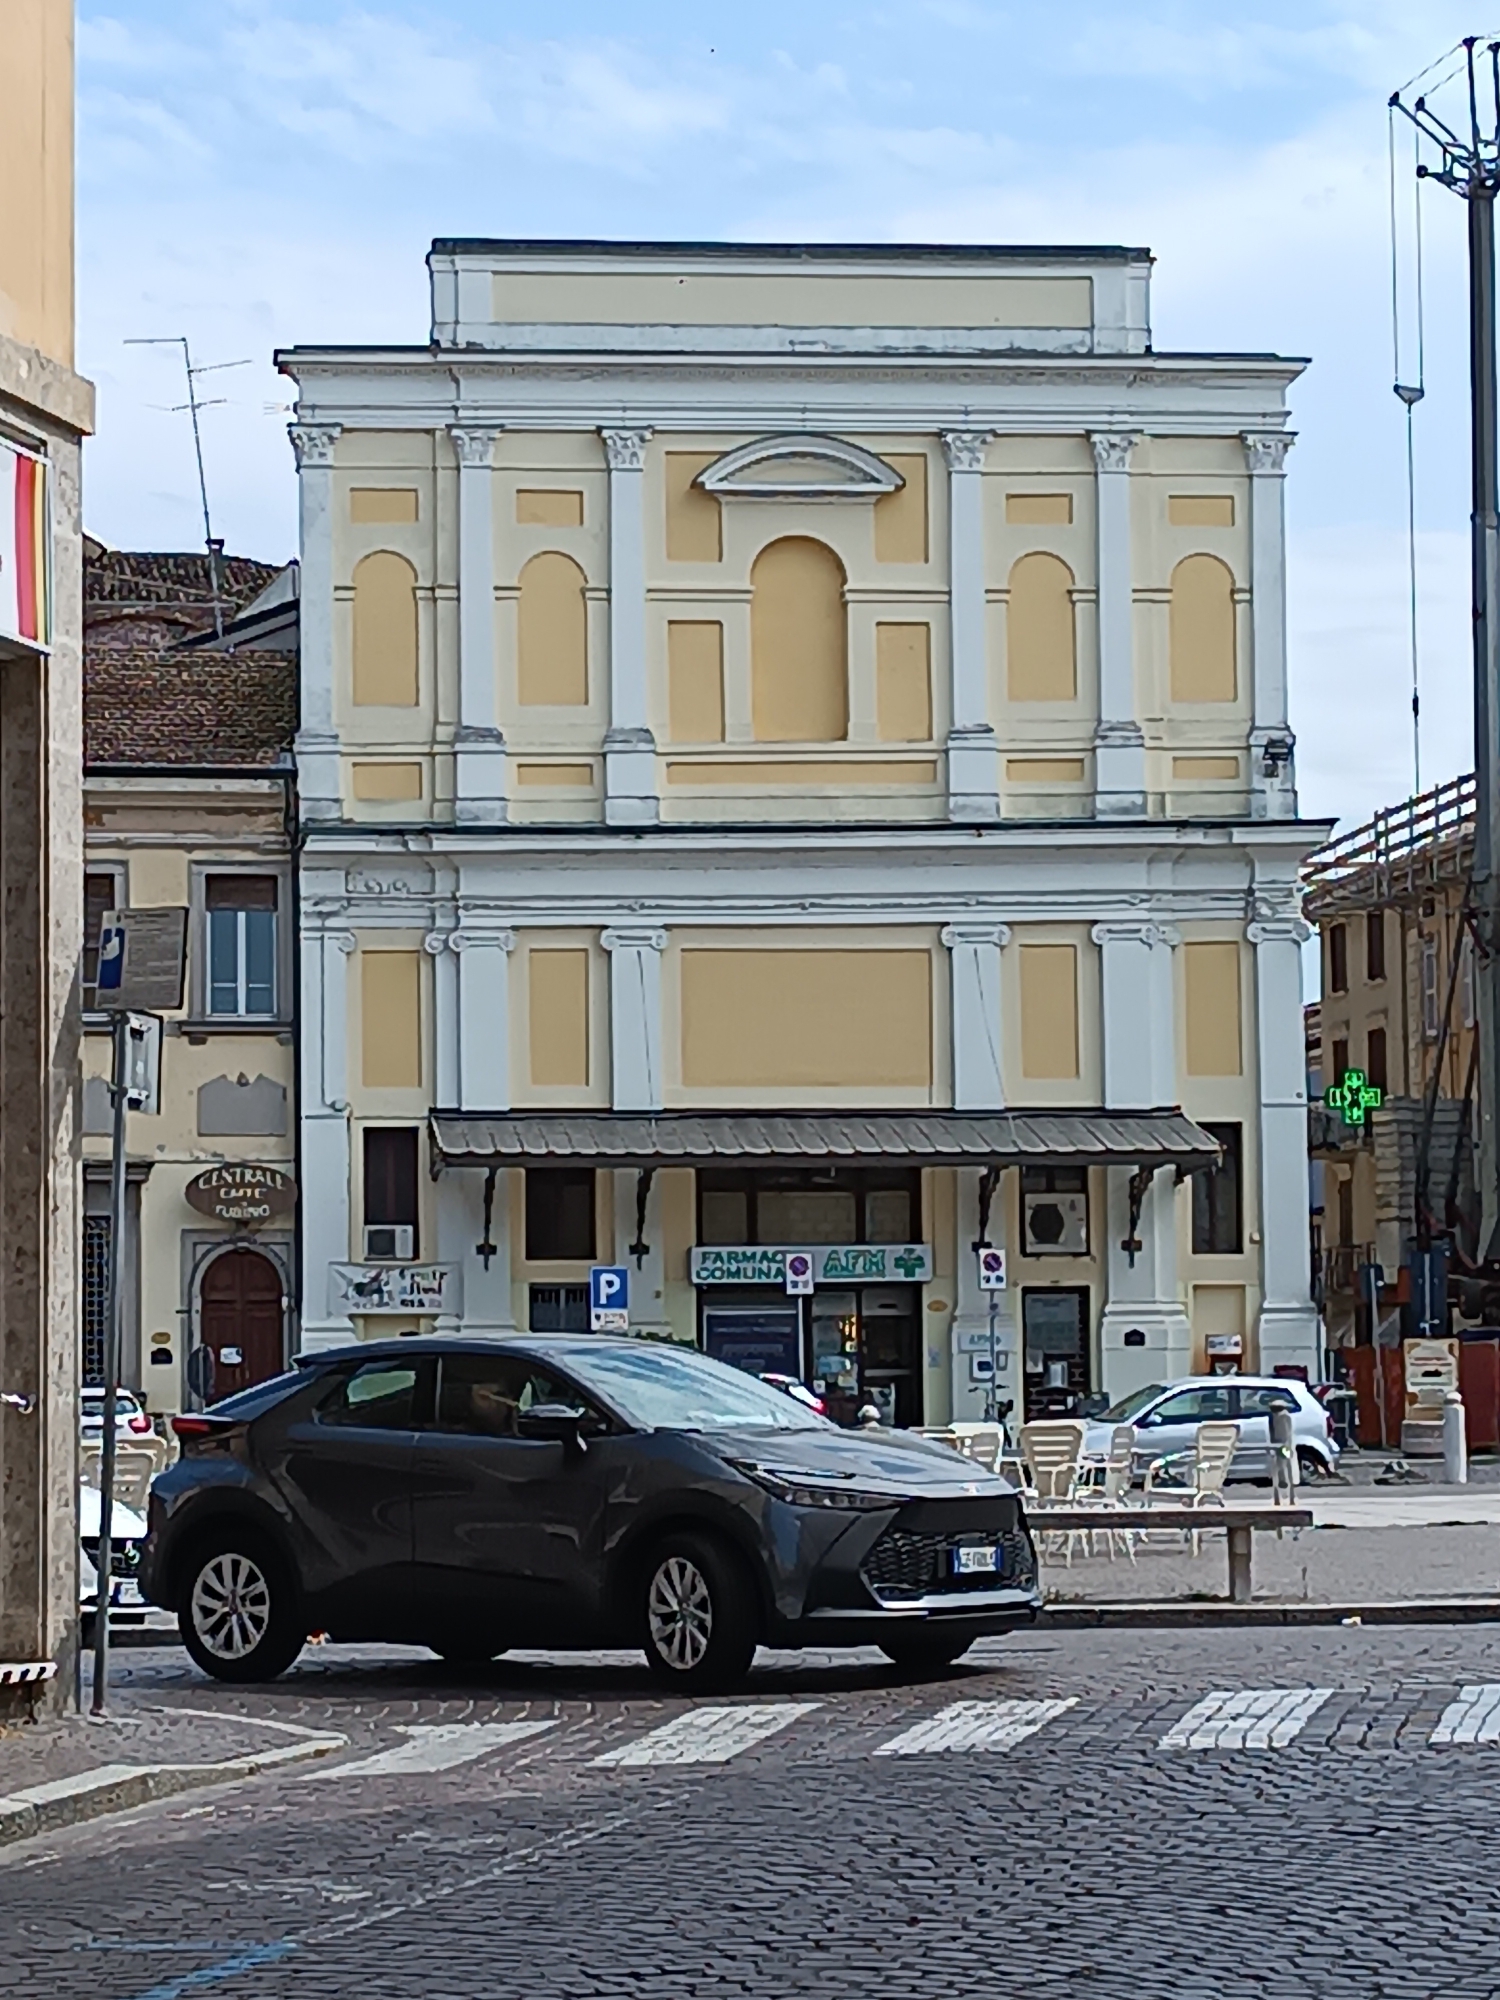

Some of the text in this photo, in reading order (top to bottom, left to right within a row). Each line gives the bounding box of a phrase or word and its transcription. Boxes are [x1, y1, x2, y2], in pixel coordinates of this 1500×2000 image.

[696, 1266, 786, 1280] COMUNA
[701, 1249, 886, 1279] FARMAC AFM
[599, 1272, 621, 1305] P
